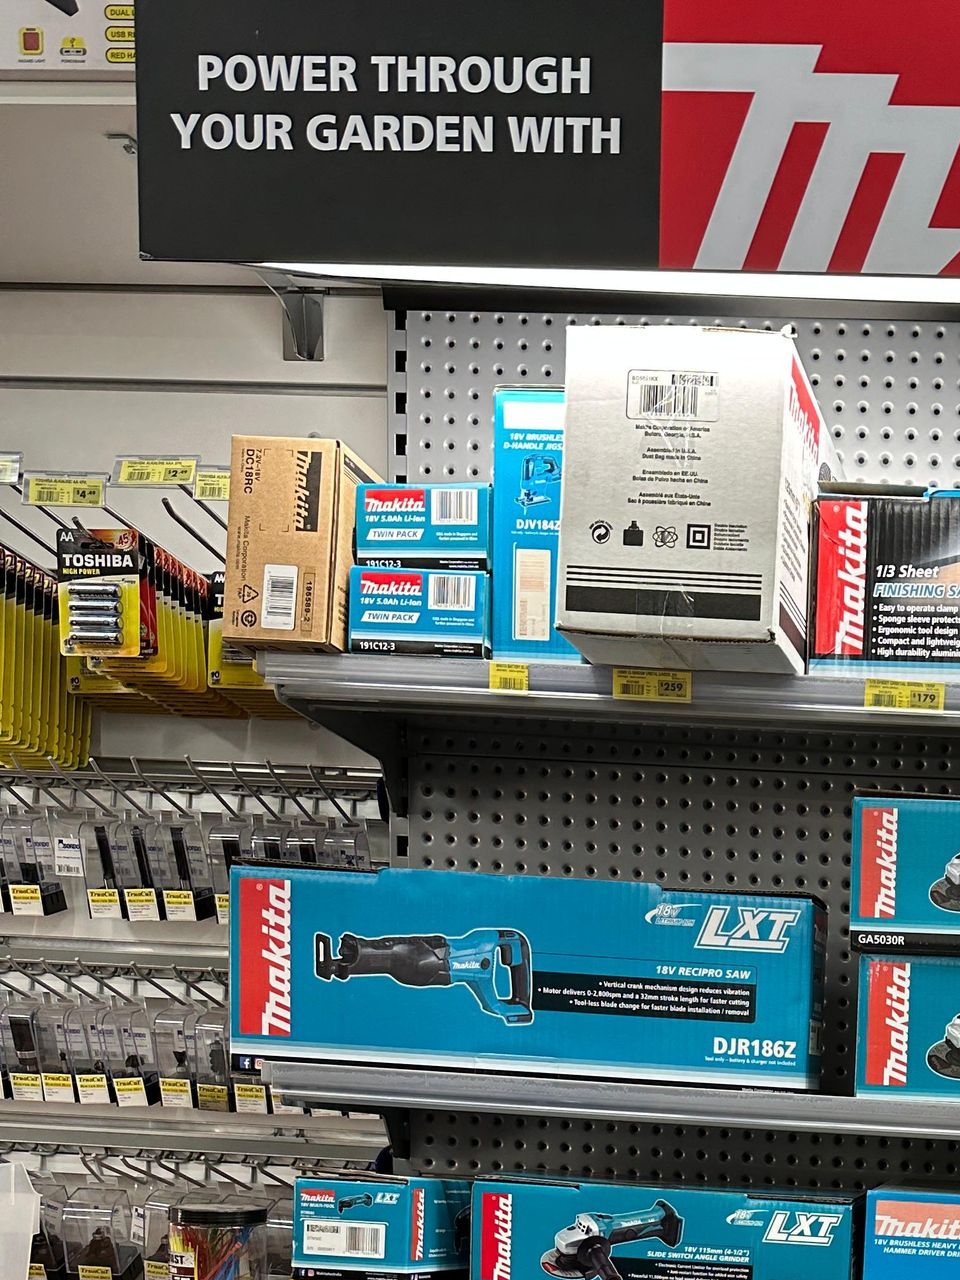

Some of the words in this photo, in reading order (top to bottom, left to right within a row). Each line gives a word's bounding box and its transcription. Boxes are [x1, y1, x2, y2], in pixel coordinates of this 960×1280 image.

[198, 55, 357, 94] POWER
[371, 56, 591, 95] THROUGH
[171, 113, 293, 152] YOUR
[307, 115, 494, 155] GARDEN
[508, 116, 622, 156] WITH
[244, 449, 255, 494] DC18RC
[60, 532, 74, 542] AA
[62, 554, 133, 568] TOSHIBA
[876, 566, 895, 578] 1/3
[898, 565, 939, 578] Sheet
[873, 584, 945, 597] FINISHING
[360, 596, 377, 605] 18V
[378, 596, 400, 605] 5.0Ah
[402, 597, 422, 606] Li-Ion
[366, 612, 387, 621] TWIN
[388, 612, 414, 622] PACK
[359, 641, 395, 650] 191C12-3
[878, 637, 907, 646] Compact
[910, 638, 923, 646] and
[661, 682, 683, 692] $259
[913, 692, 936, 703] $179
[694, 905, 802, 954] LXT
[858, 934, 905, 946] GA5030R
[655, 964, 678, 976] 18V
[681, 965, 724, 979] RECIPRO
[726, 968, 750, 980] SAW
[713, 1037, 796, 1059] DJR186Z
[763, 1210, 843, 1248] LXT
[874, 1238, 888, 1246] 18V
[889, 1238, 929, 1248] BRUSHLESS
[932, 1241, 956, 1249] HEAVY
[883, 1247, 916, 1255] HAMMER
[918, 1249, 944, 1257] DRIVER
